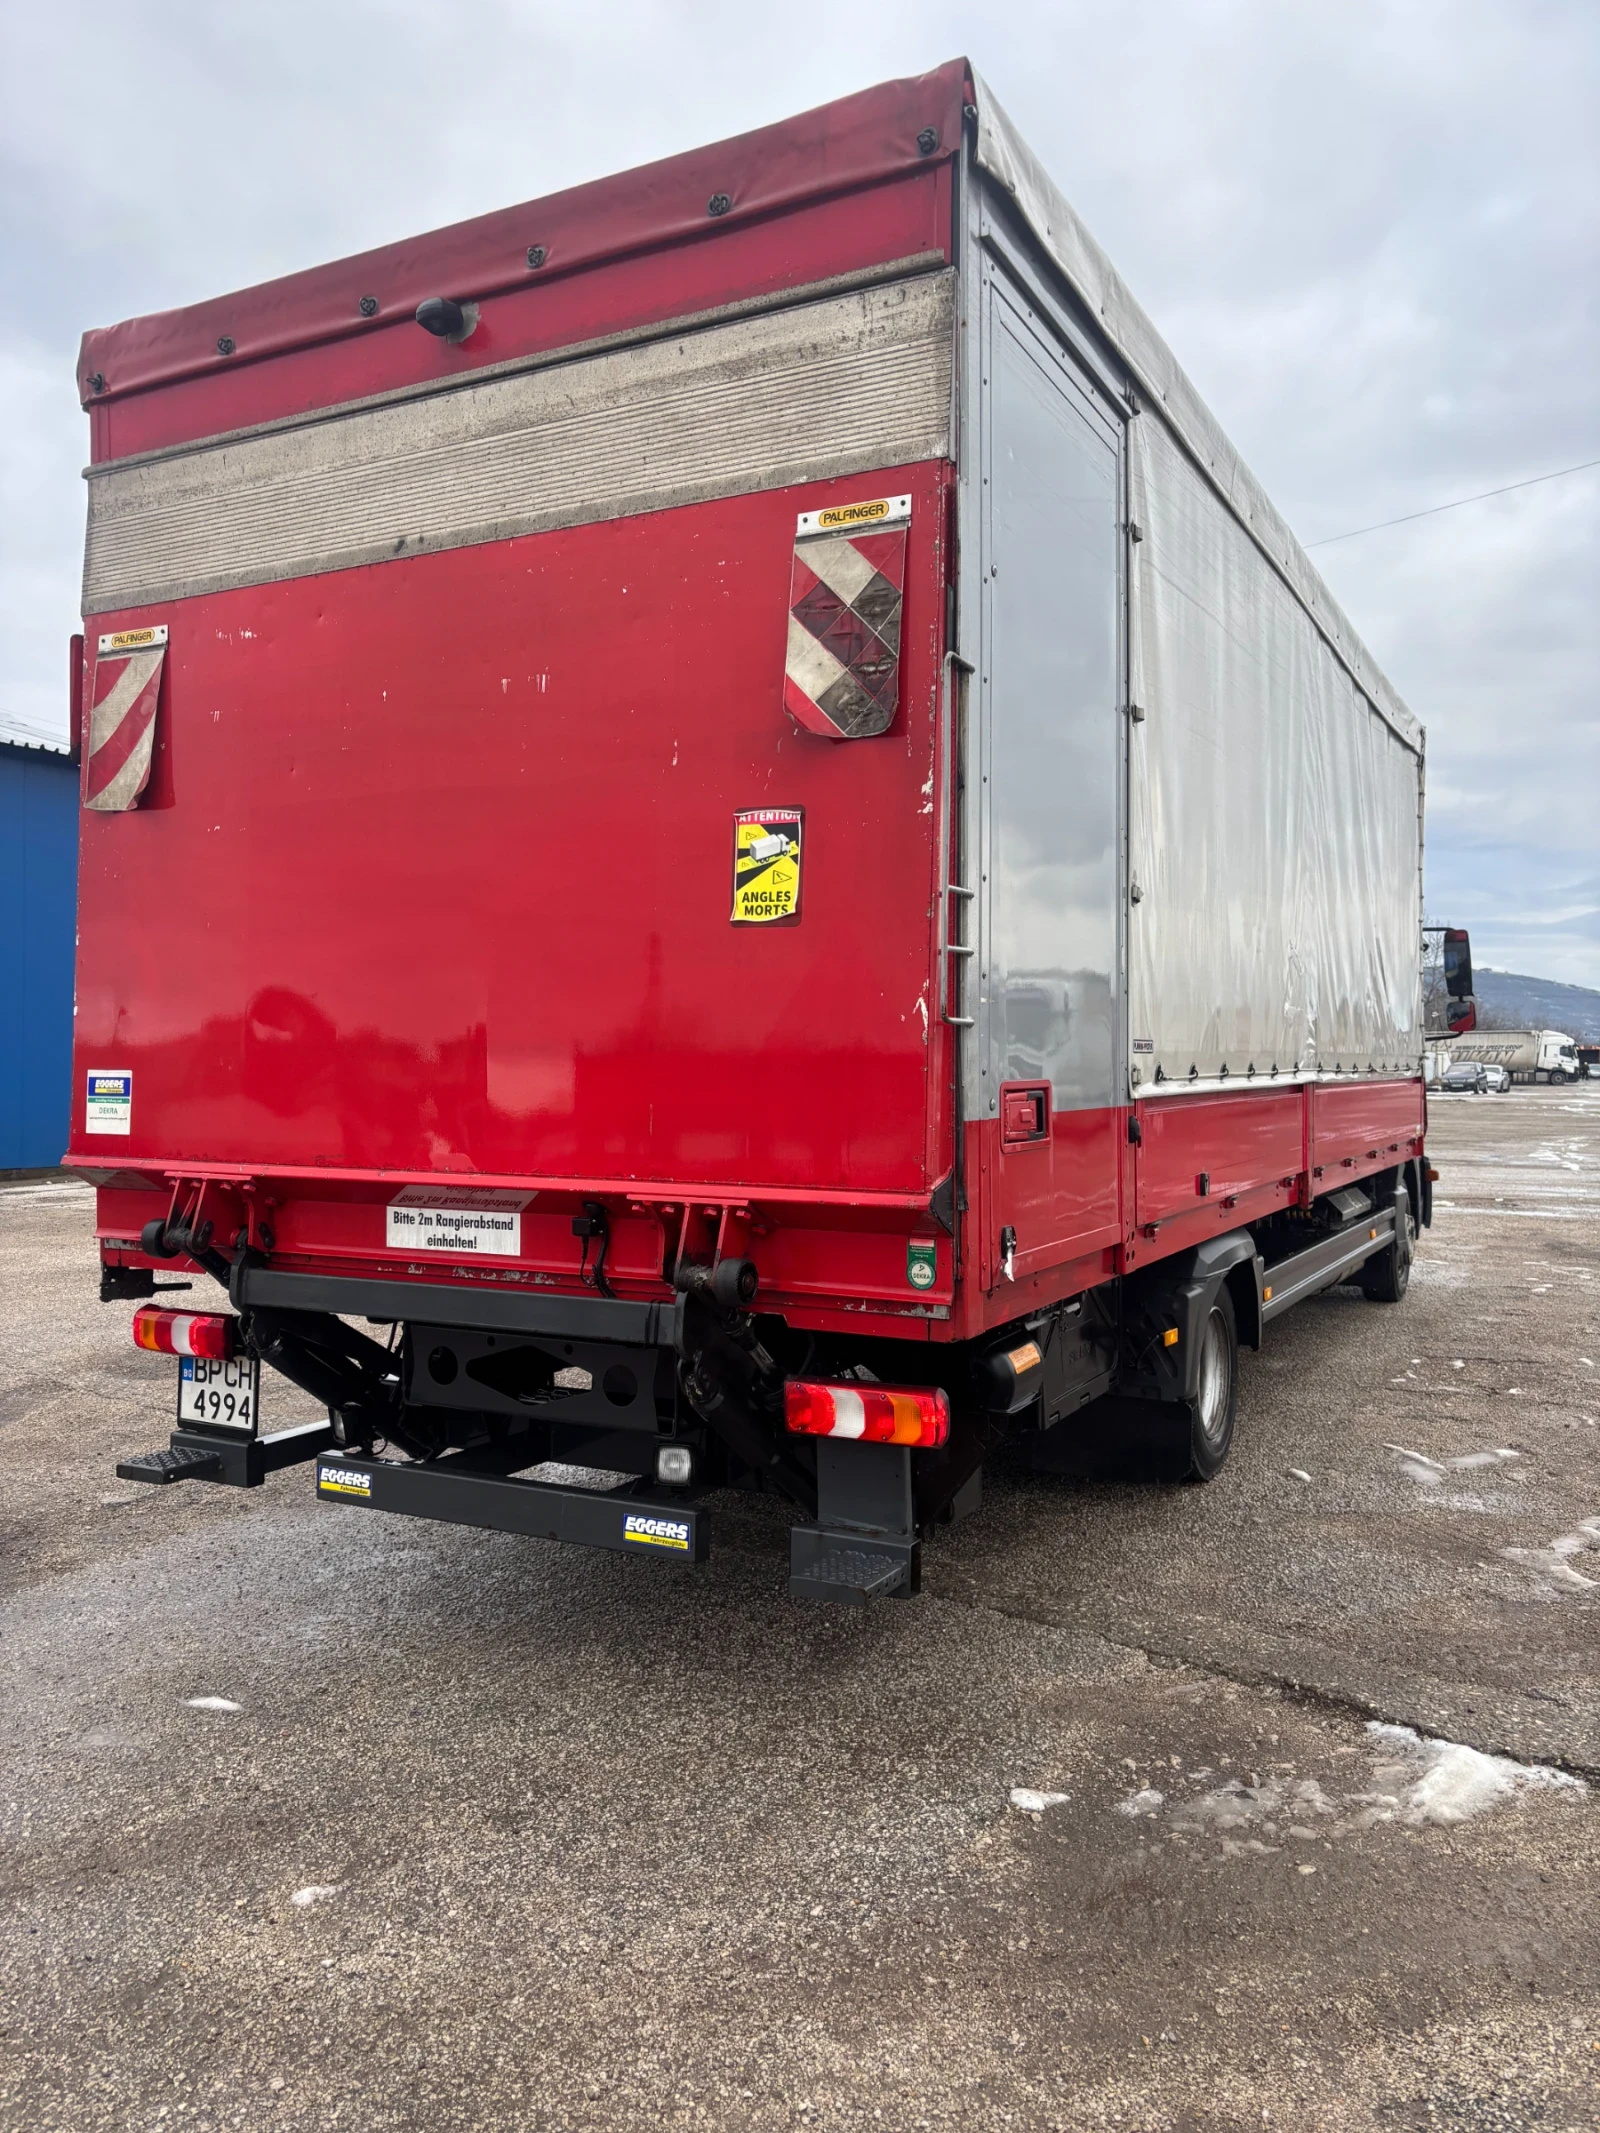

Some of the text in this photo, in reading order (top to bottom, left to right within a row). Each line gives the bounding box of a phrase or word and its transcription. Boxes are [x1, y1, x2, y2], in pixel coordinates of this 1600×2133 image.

[823, 504, 884, 524] PALFINGER
[114, 631, 152, 645] PALFINGER
[742, 890, 791, 903] ANGLES
[744, 904, 789, 916] MORTS
[393, 1211, 514, 1231] Bitte 2m Rangierabstand
[427, 1233, 477, 1249] einhalten!
[194, 1388, 251, 1425] 4994
[320, 1467, 371, 1488] EGGERS
[625, 1516, 688, 1540] EGGERS
[650, 1536, 686, 1548] Fahrzeugbau
